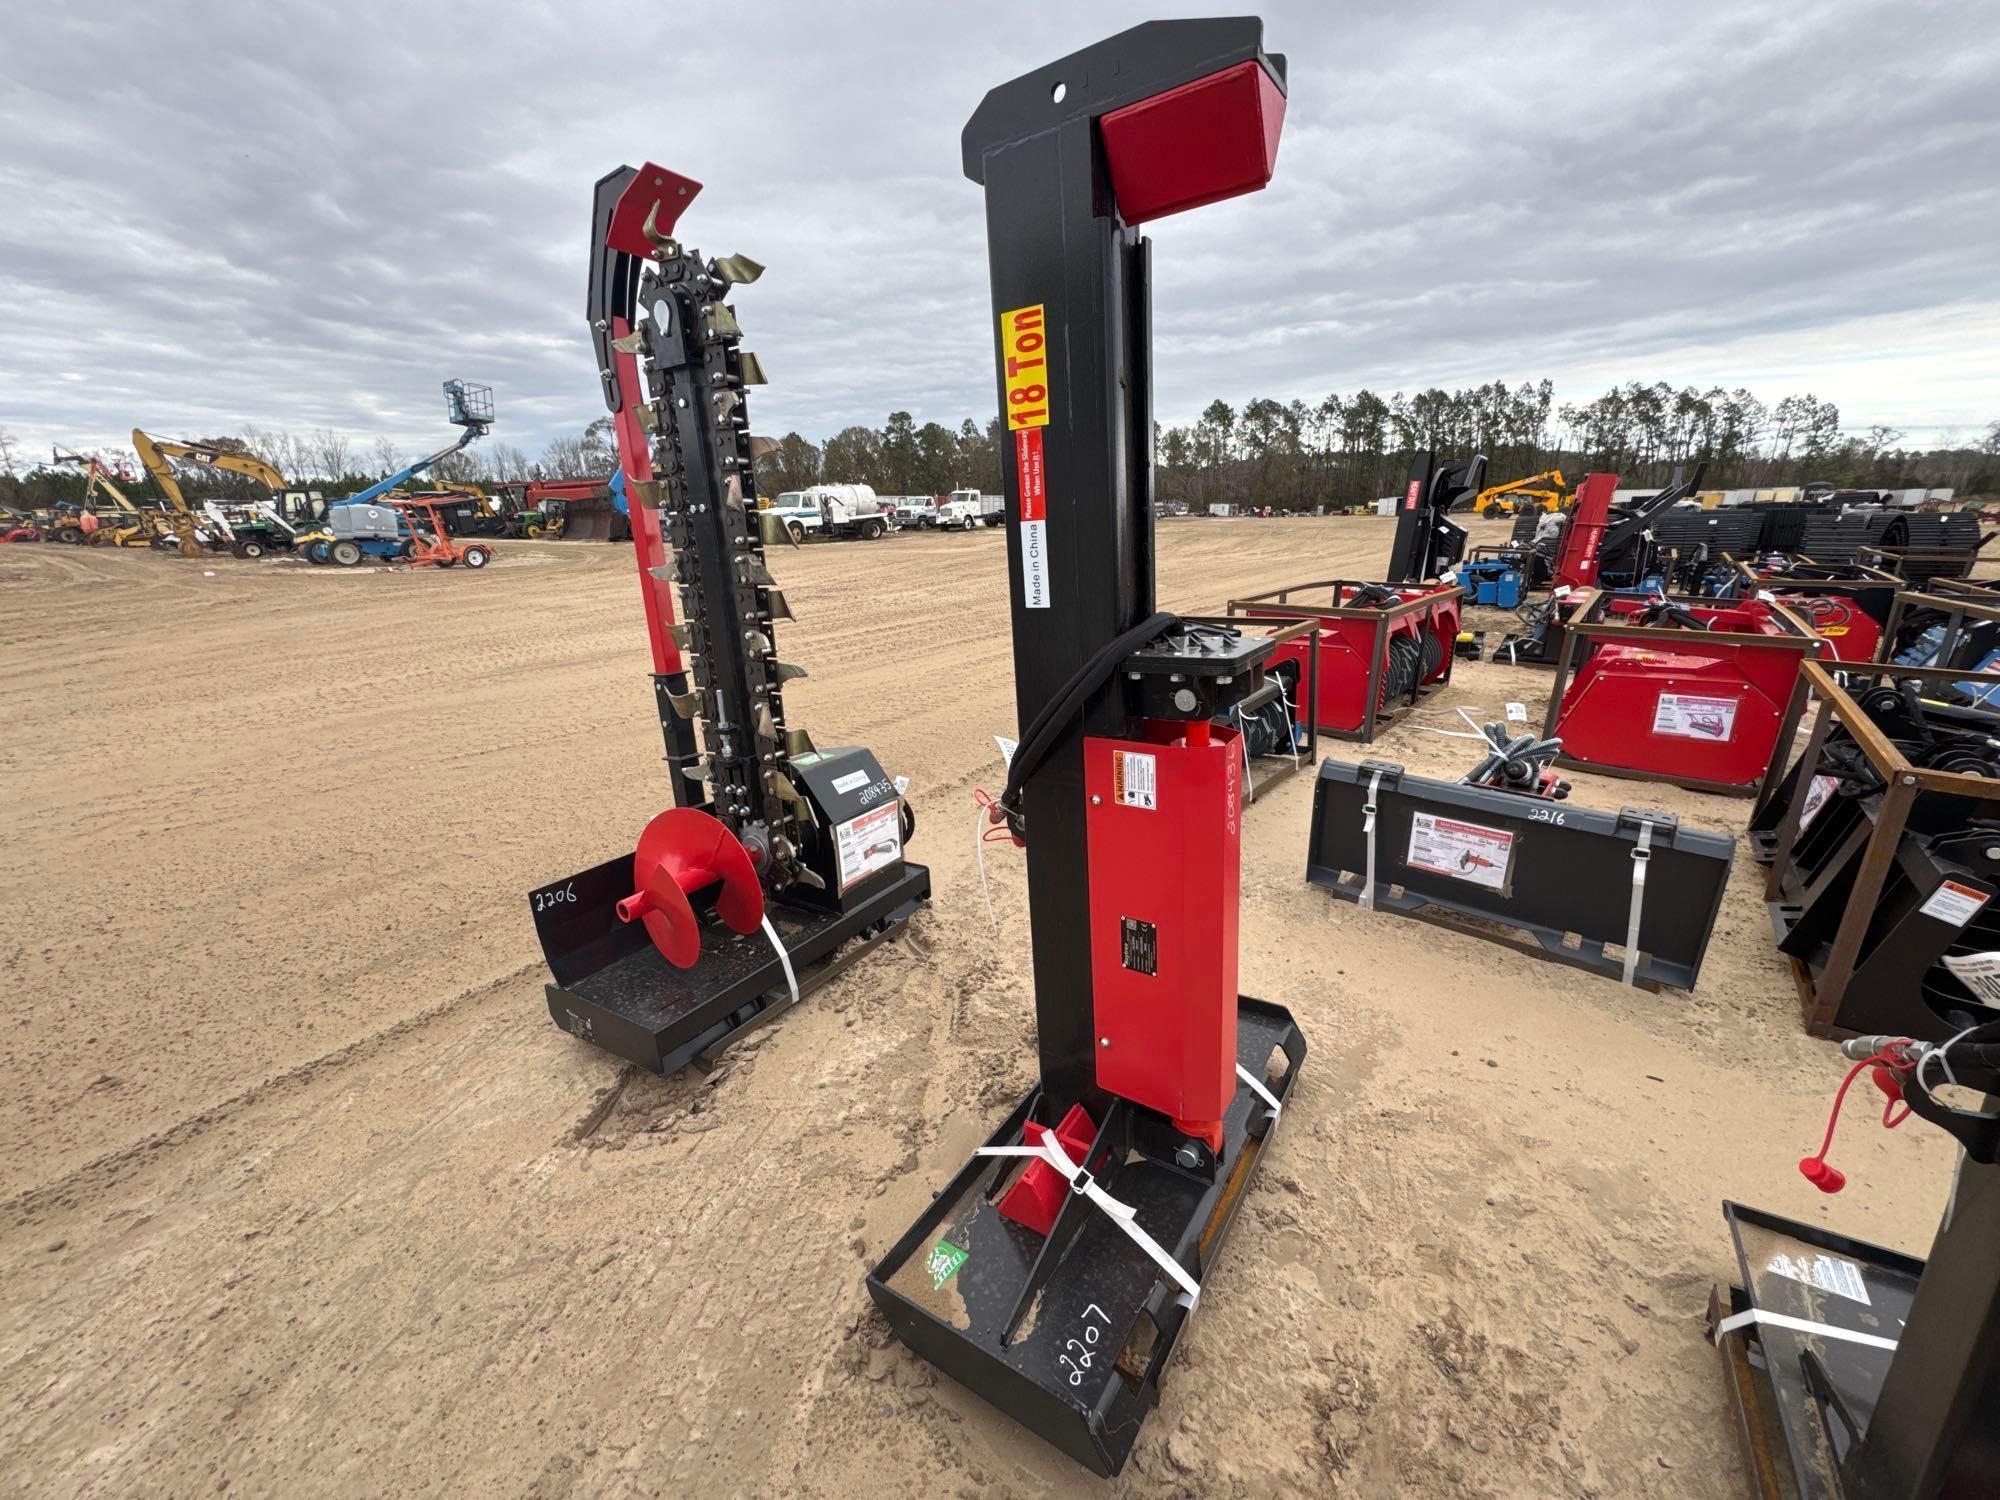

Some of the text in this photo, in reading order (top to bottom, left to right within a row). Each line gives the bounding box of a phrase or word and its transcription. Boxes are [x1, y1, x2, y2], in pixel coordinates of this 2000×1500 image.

[1008, 308, 1046, 425] 18 Ton
[195, 453, 211, 463] CAT
[1021, 430, 1029, 461] Slideway
[1022, 461, 1030, 474] the
[1029, 524, 1041, 605] Made in China
[1116, 757, 1124, 791] WARNING
[1227, 744, 1236, 835] 208436
[859, 778, 892, 805] 208435
[1528, 808, 1565, 825] 2216
[536, 882, 577, 912] 2206
[1059, 1304, 1112, 1386] 2207
